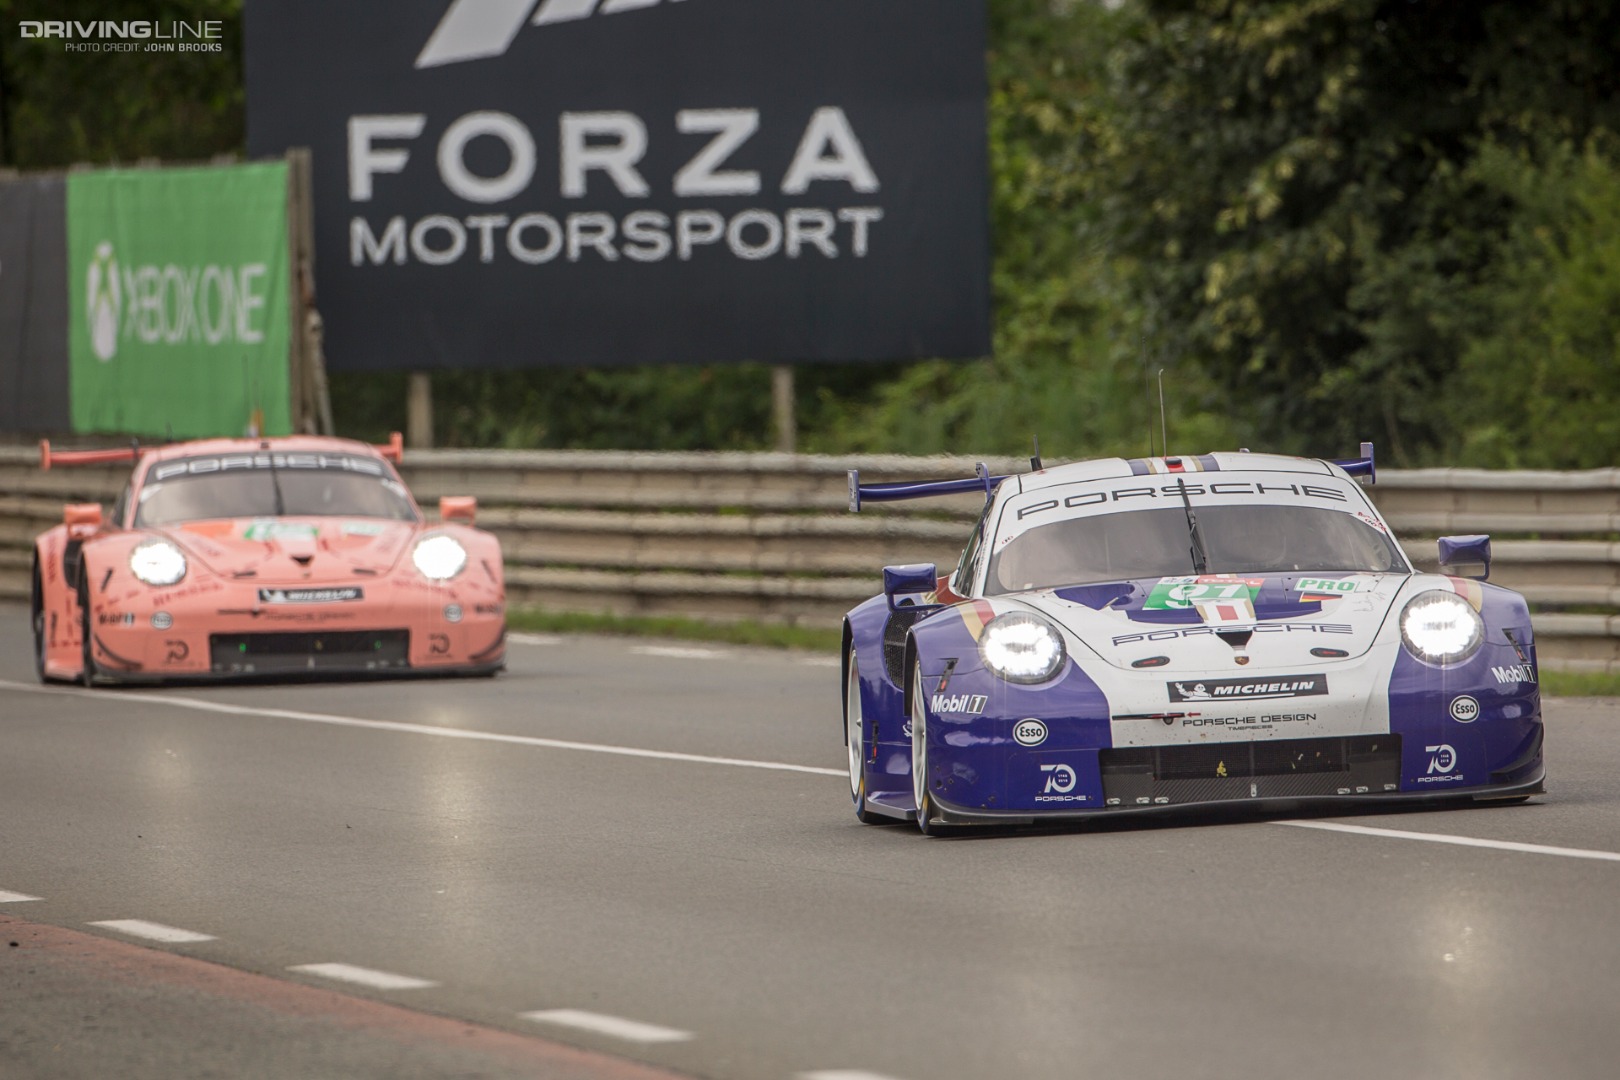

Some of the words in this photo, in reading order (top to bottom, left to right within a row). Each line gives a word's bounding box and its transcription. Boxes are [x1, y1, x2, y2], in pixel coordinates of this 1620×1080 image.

[347, 106, 881, 203] FORZA
[350, 207, 884, 266] MOTORSPORT
[1017, 482, 1348, 521] PORSCHE
[1300, 579, 1355, 592] PRO
[1165, 584, 1243, 609] 91
[1491, 665, 1527, 683] Mobil
[1213, 681, 1314, 696] MICHELIN
[930, 694, 970, 714] Mobil
[1455, 703, 1475, 714] Esso
[1182, 716, 1256, 727] PORSCHE
[1261, 713, 1317, 723] DESIGN
[1019, 726, 1043, 738] Esso
[1417, 774, 1464, 783] PORSCHE
